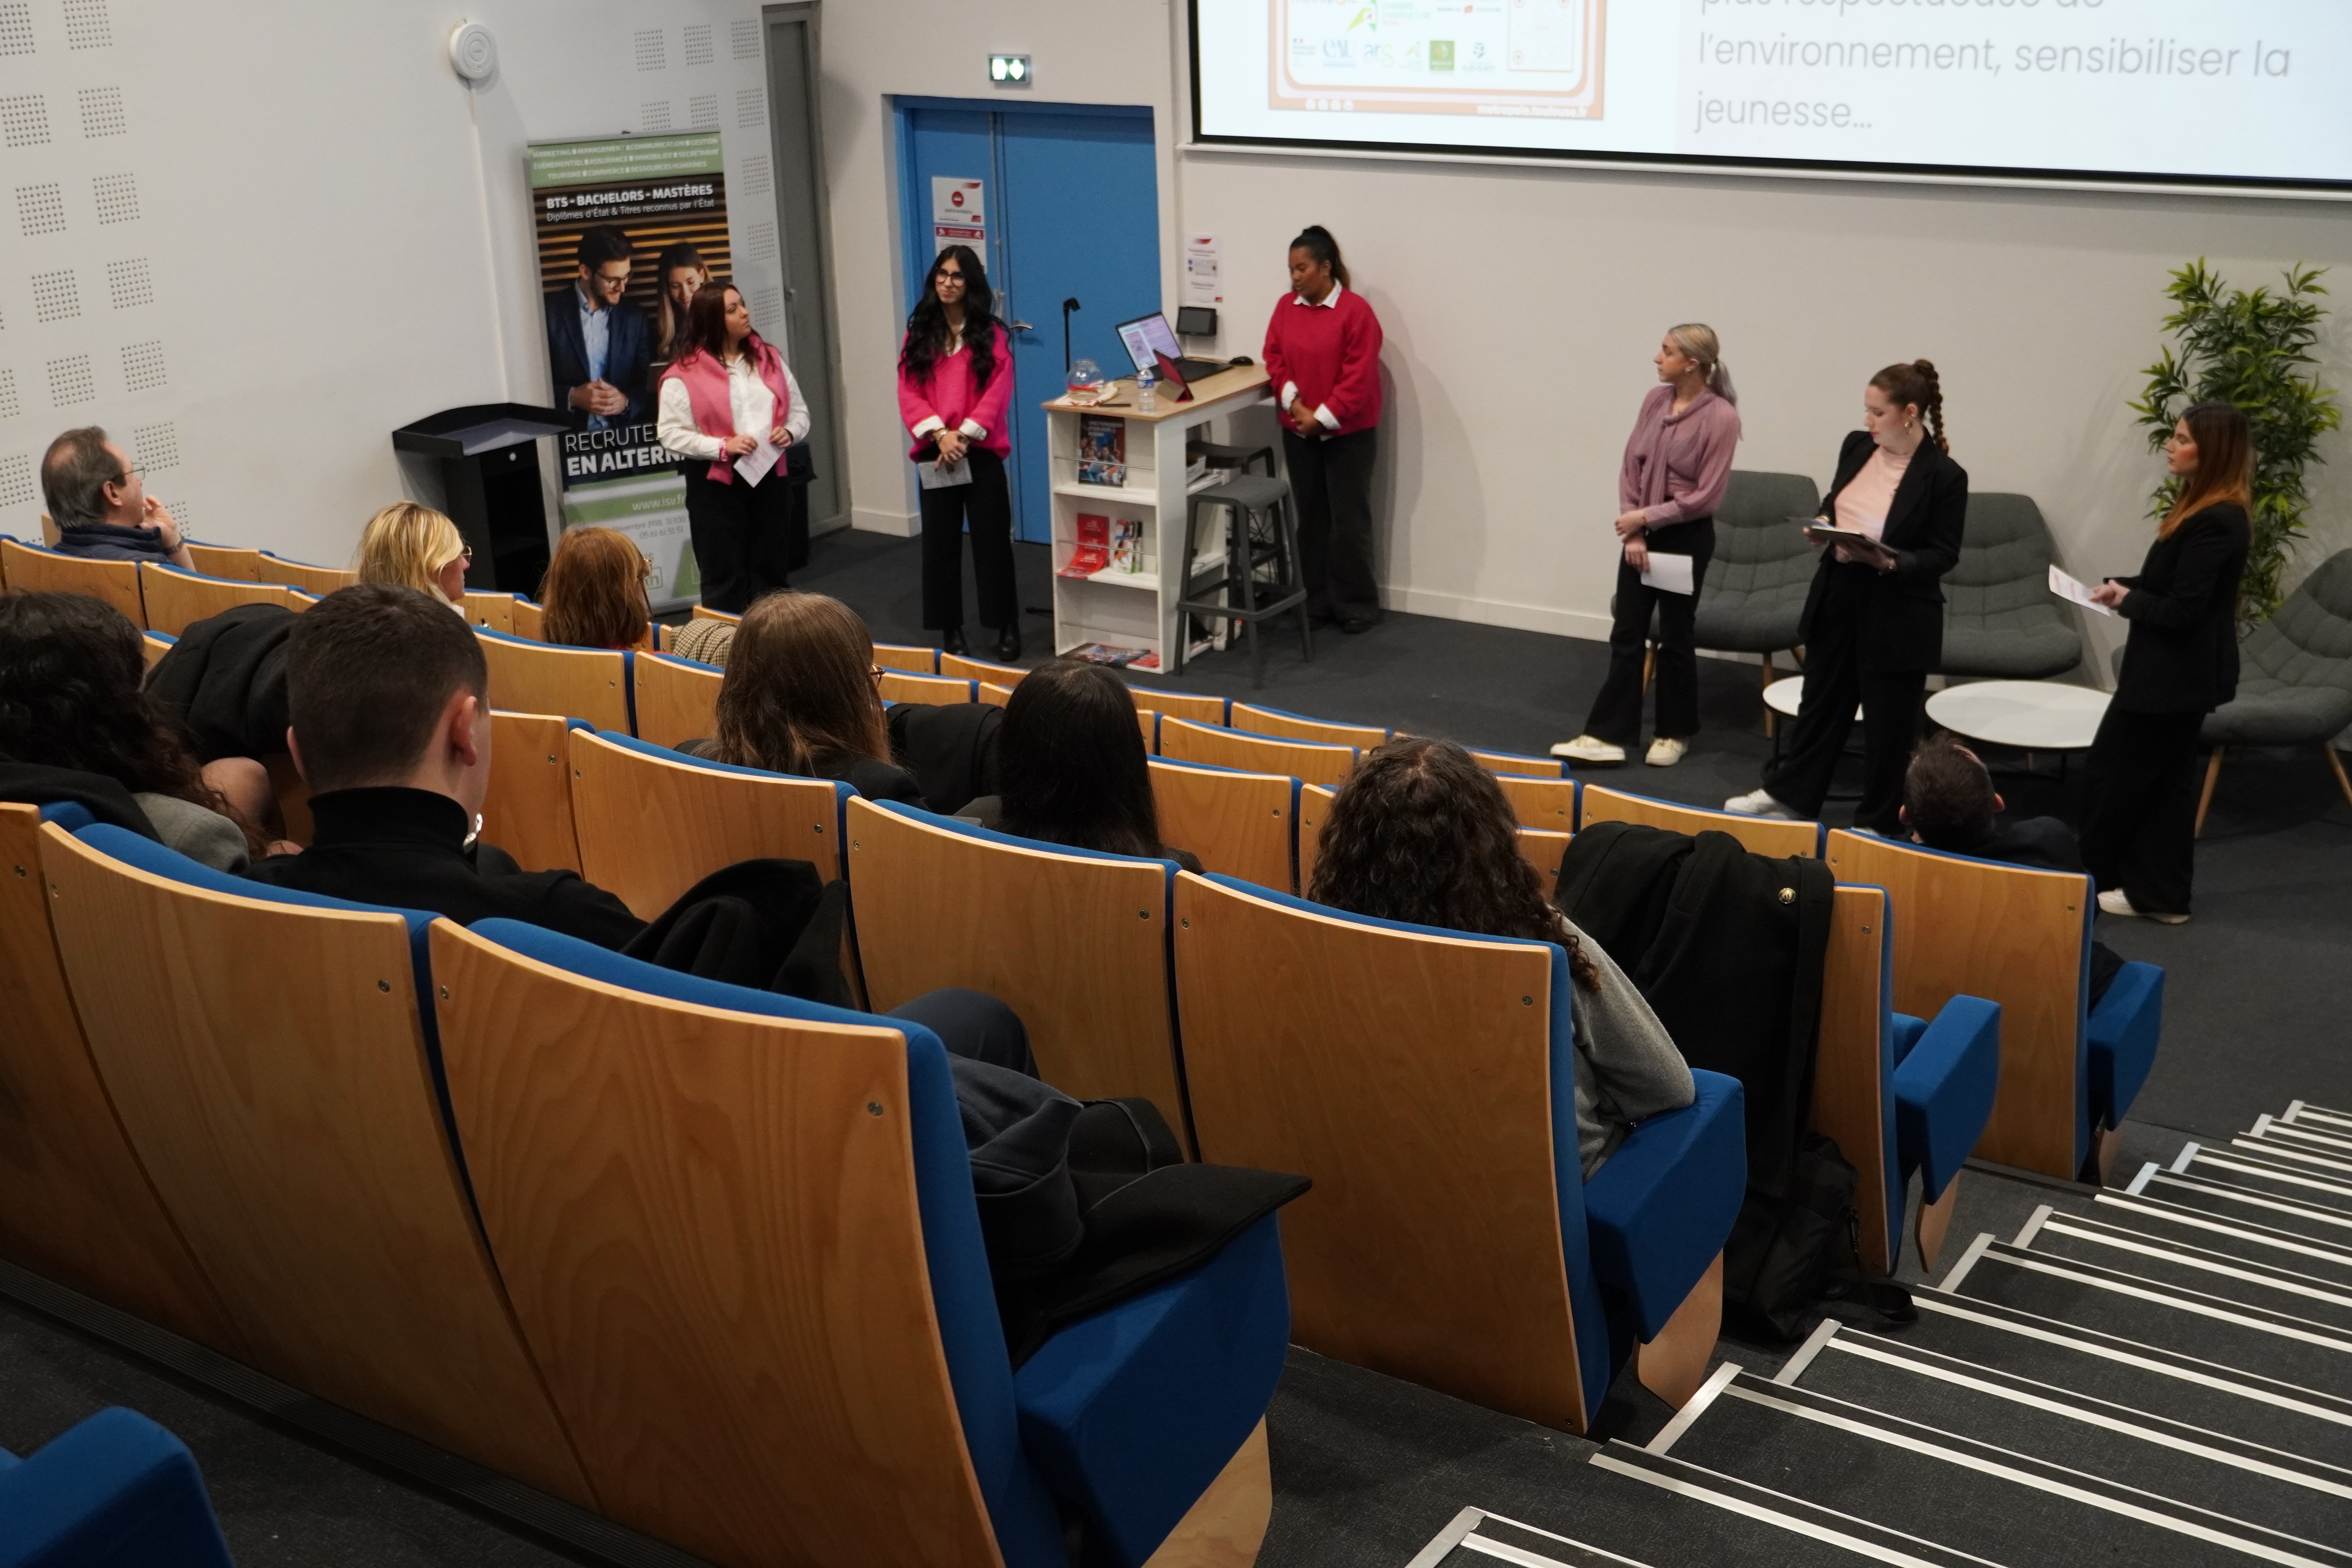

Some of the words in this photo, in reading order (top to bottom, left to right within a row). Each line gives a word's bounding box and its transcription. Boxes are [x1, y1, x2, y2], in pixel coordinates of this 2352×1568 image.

[1700, 31, 2001, 77] l'environnement,
[2014, 37, 2241, 76] sensibiliser
[2254, 39, 2291, 77] la
[1694, 90, 1873, 133] jeunesse...
[578, 145, 624, 154] MANAGEMENT
[590, 156, 628, 165] ASSURANCE
[548, 171, 581, 180] TOURISME
[588, 167, 624, 176] COMMERCE
[631, 163, 671, 173] RESSOURCES
[546, 197, 568, 209] BTS
[577, 191, 644, 207] BACHELORS
[652, 183, 713, 199] MASTÈRES
[547, 210, 584, 222] Diplômes
[586, 207, 609, 218] d'État
[611, 207, 618, 216] &
[620, 204, 641, 214] Titres
[642, 203, 677, 213] reconnus
[679, 201, 691, 212] par
[693, 198, 715, 208] l'État
[565, 423, 659, 453] RECRUTE
[567, 454, 597, 477] EN
[601, 445, 686, 473] ALTERN
[632, 495, 686, 511] www.isv.fr
